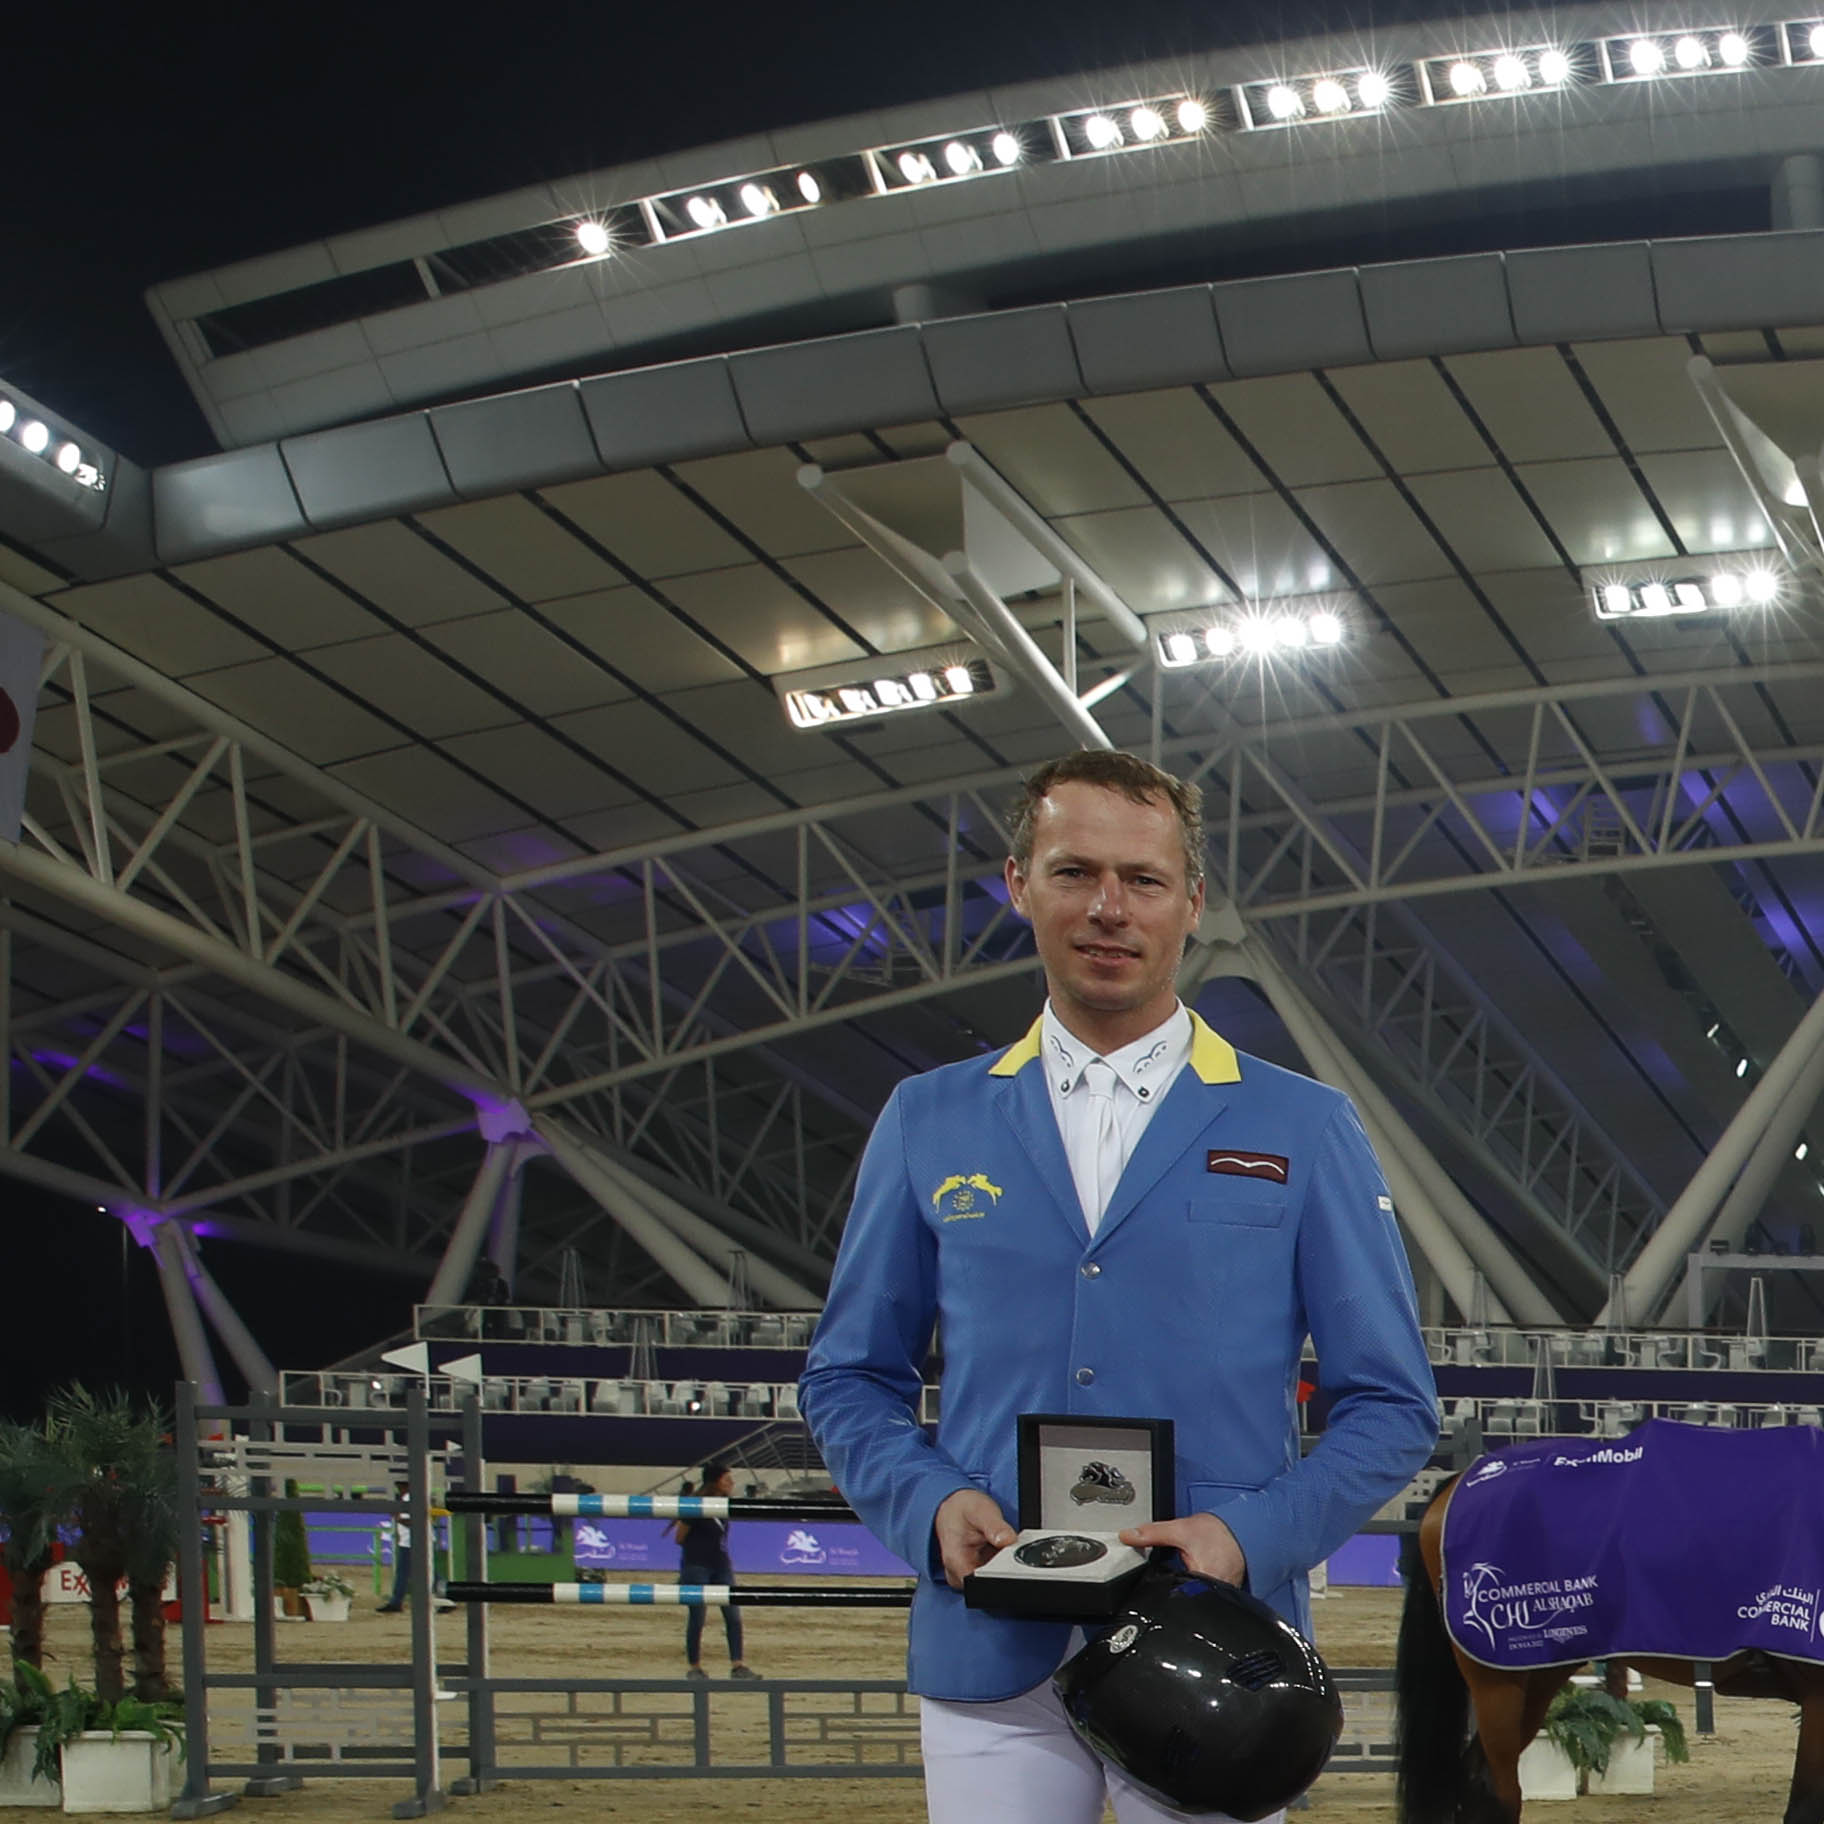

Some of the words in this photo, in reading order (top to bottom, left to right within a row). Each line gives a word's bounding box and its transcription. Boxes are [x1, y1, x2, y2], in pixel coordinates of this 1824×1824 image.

[1554, 1447, 1643, 1468] ExnMobil
[1564, 1575, 1599, 1592] BANK
[1737, 1600, 1811, 1621] COERCIAL
[1771, 1614, 1809, 1632] BANK
